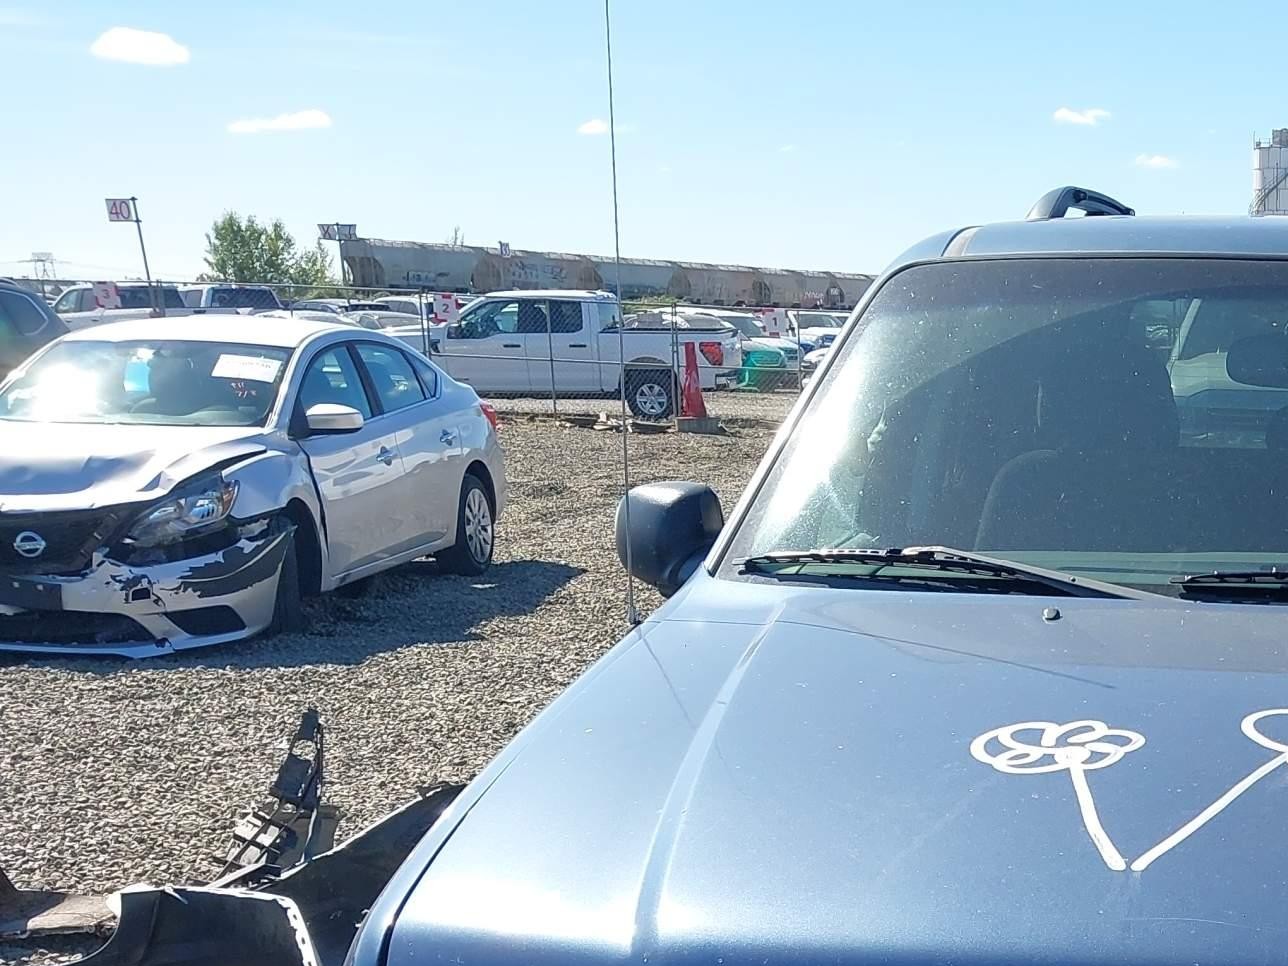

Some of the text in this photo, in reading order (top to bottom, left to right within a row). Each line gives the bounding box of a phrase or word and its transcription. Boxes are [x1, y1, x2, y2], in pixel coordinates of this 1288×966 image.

[110, 201, 130, 219] 40
[102, 288, 111, 299] 3
[442, 303, 450, 313] 2
